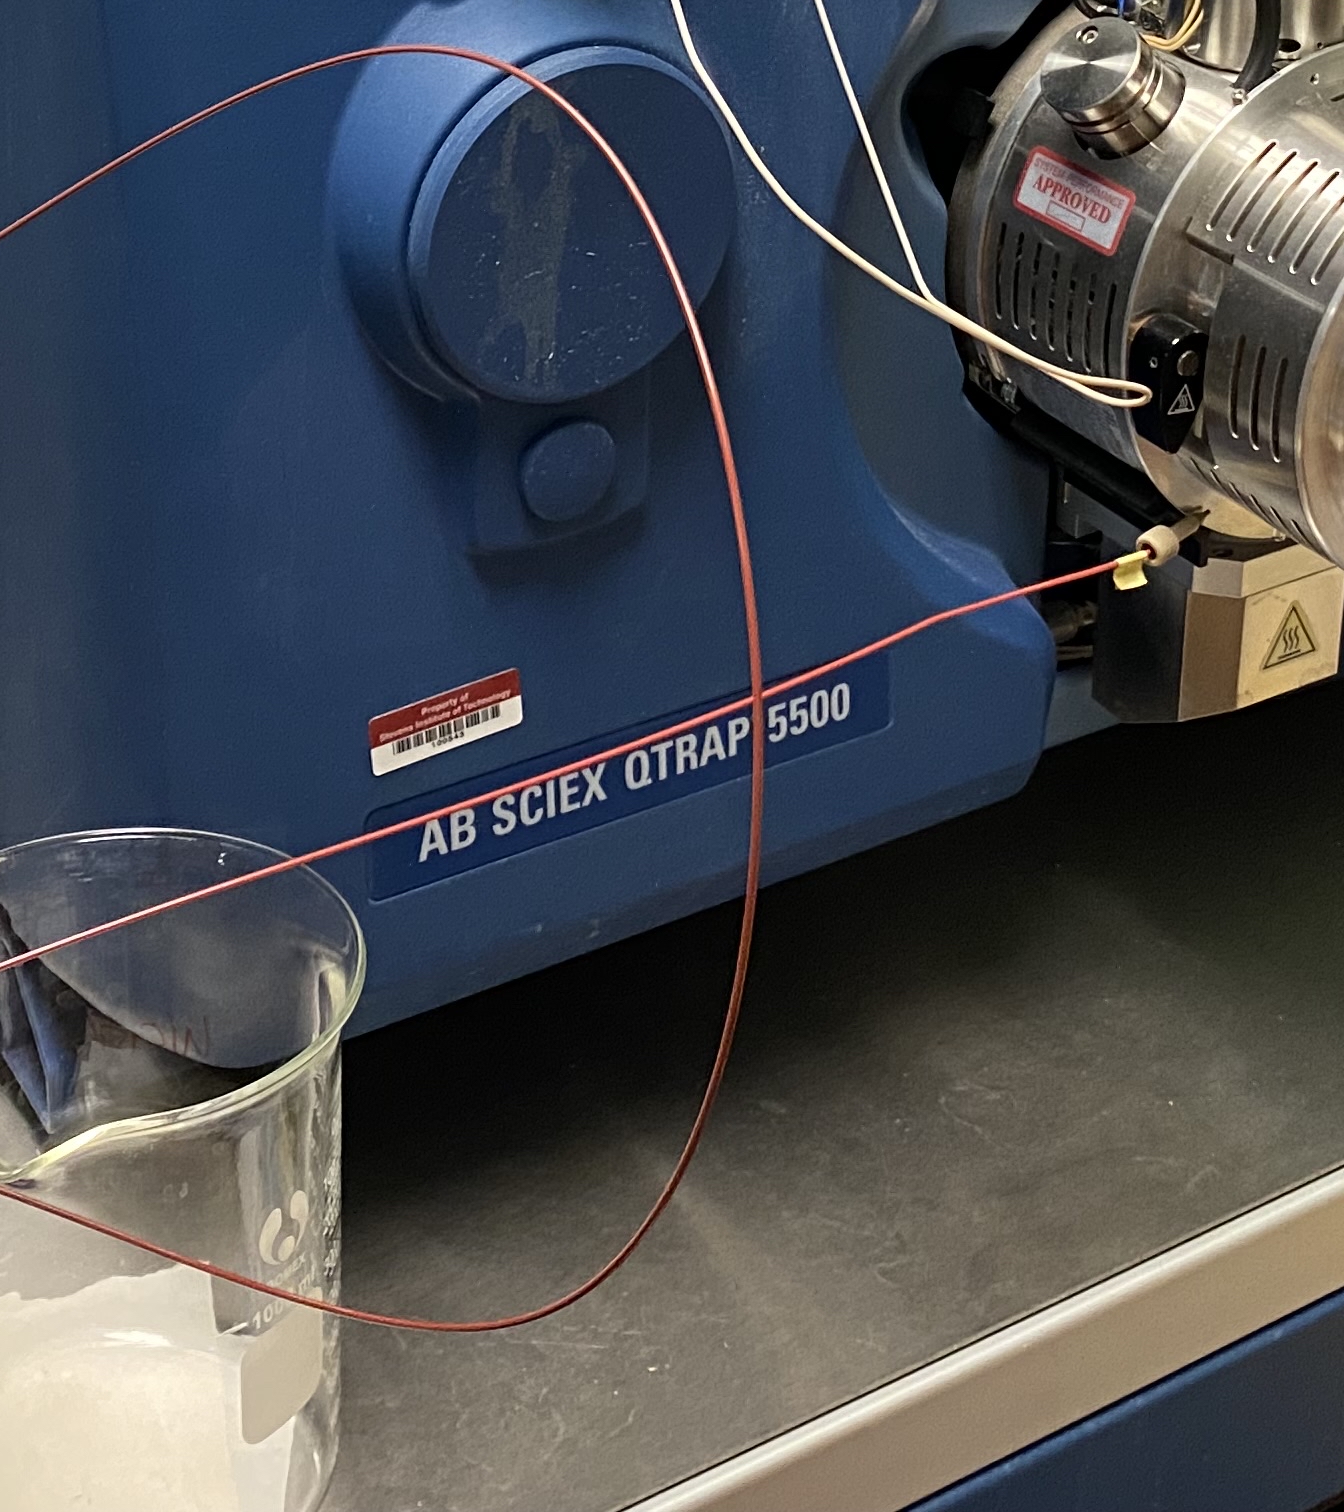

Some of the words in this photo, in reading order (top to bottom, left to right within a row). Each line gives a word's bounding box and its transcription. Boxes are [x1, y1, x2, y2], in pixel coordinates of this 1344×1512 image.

[1032, 174, 1112, 224] APPROVED
[415, 710, 451, 729] Institute
[453, 707, 462, 716] of
[463, 690, 511, 712] Technology
[421, 696, 457, 716] Property
[460, 693, 469, 703] of
[418, 808, 477, 863] AB
[492, 762, 608, 837] SCIEX
[625, 715, 751, 790] QTRAP
[768, 683, 851, 743] 5500
